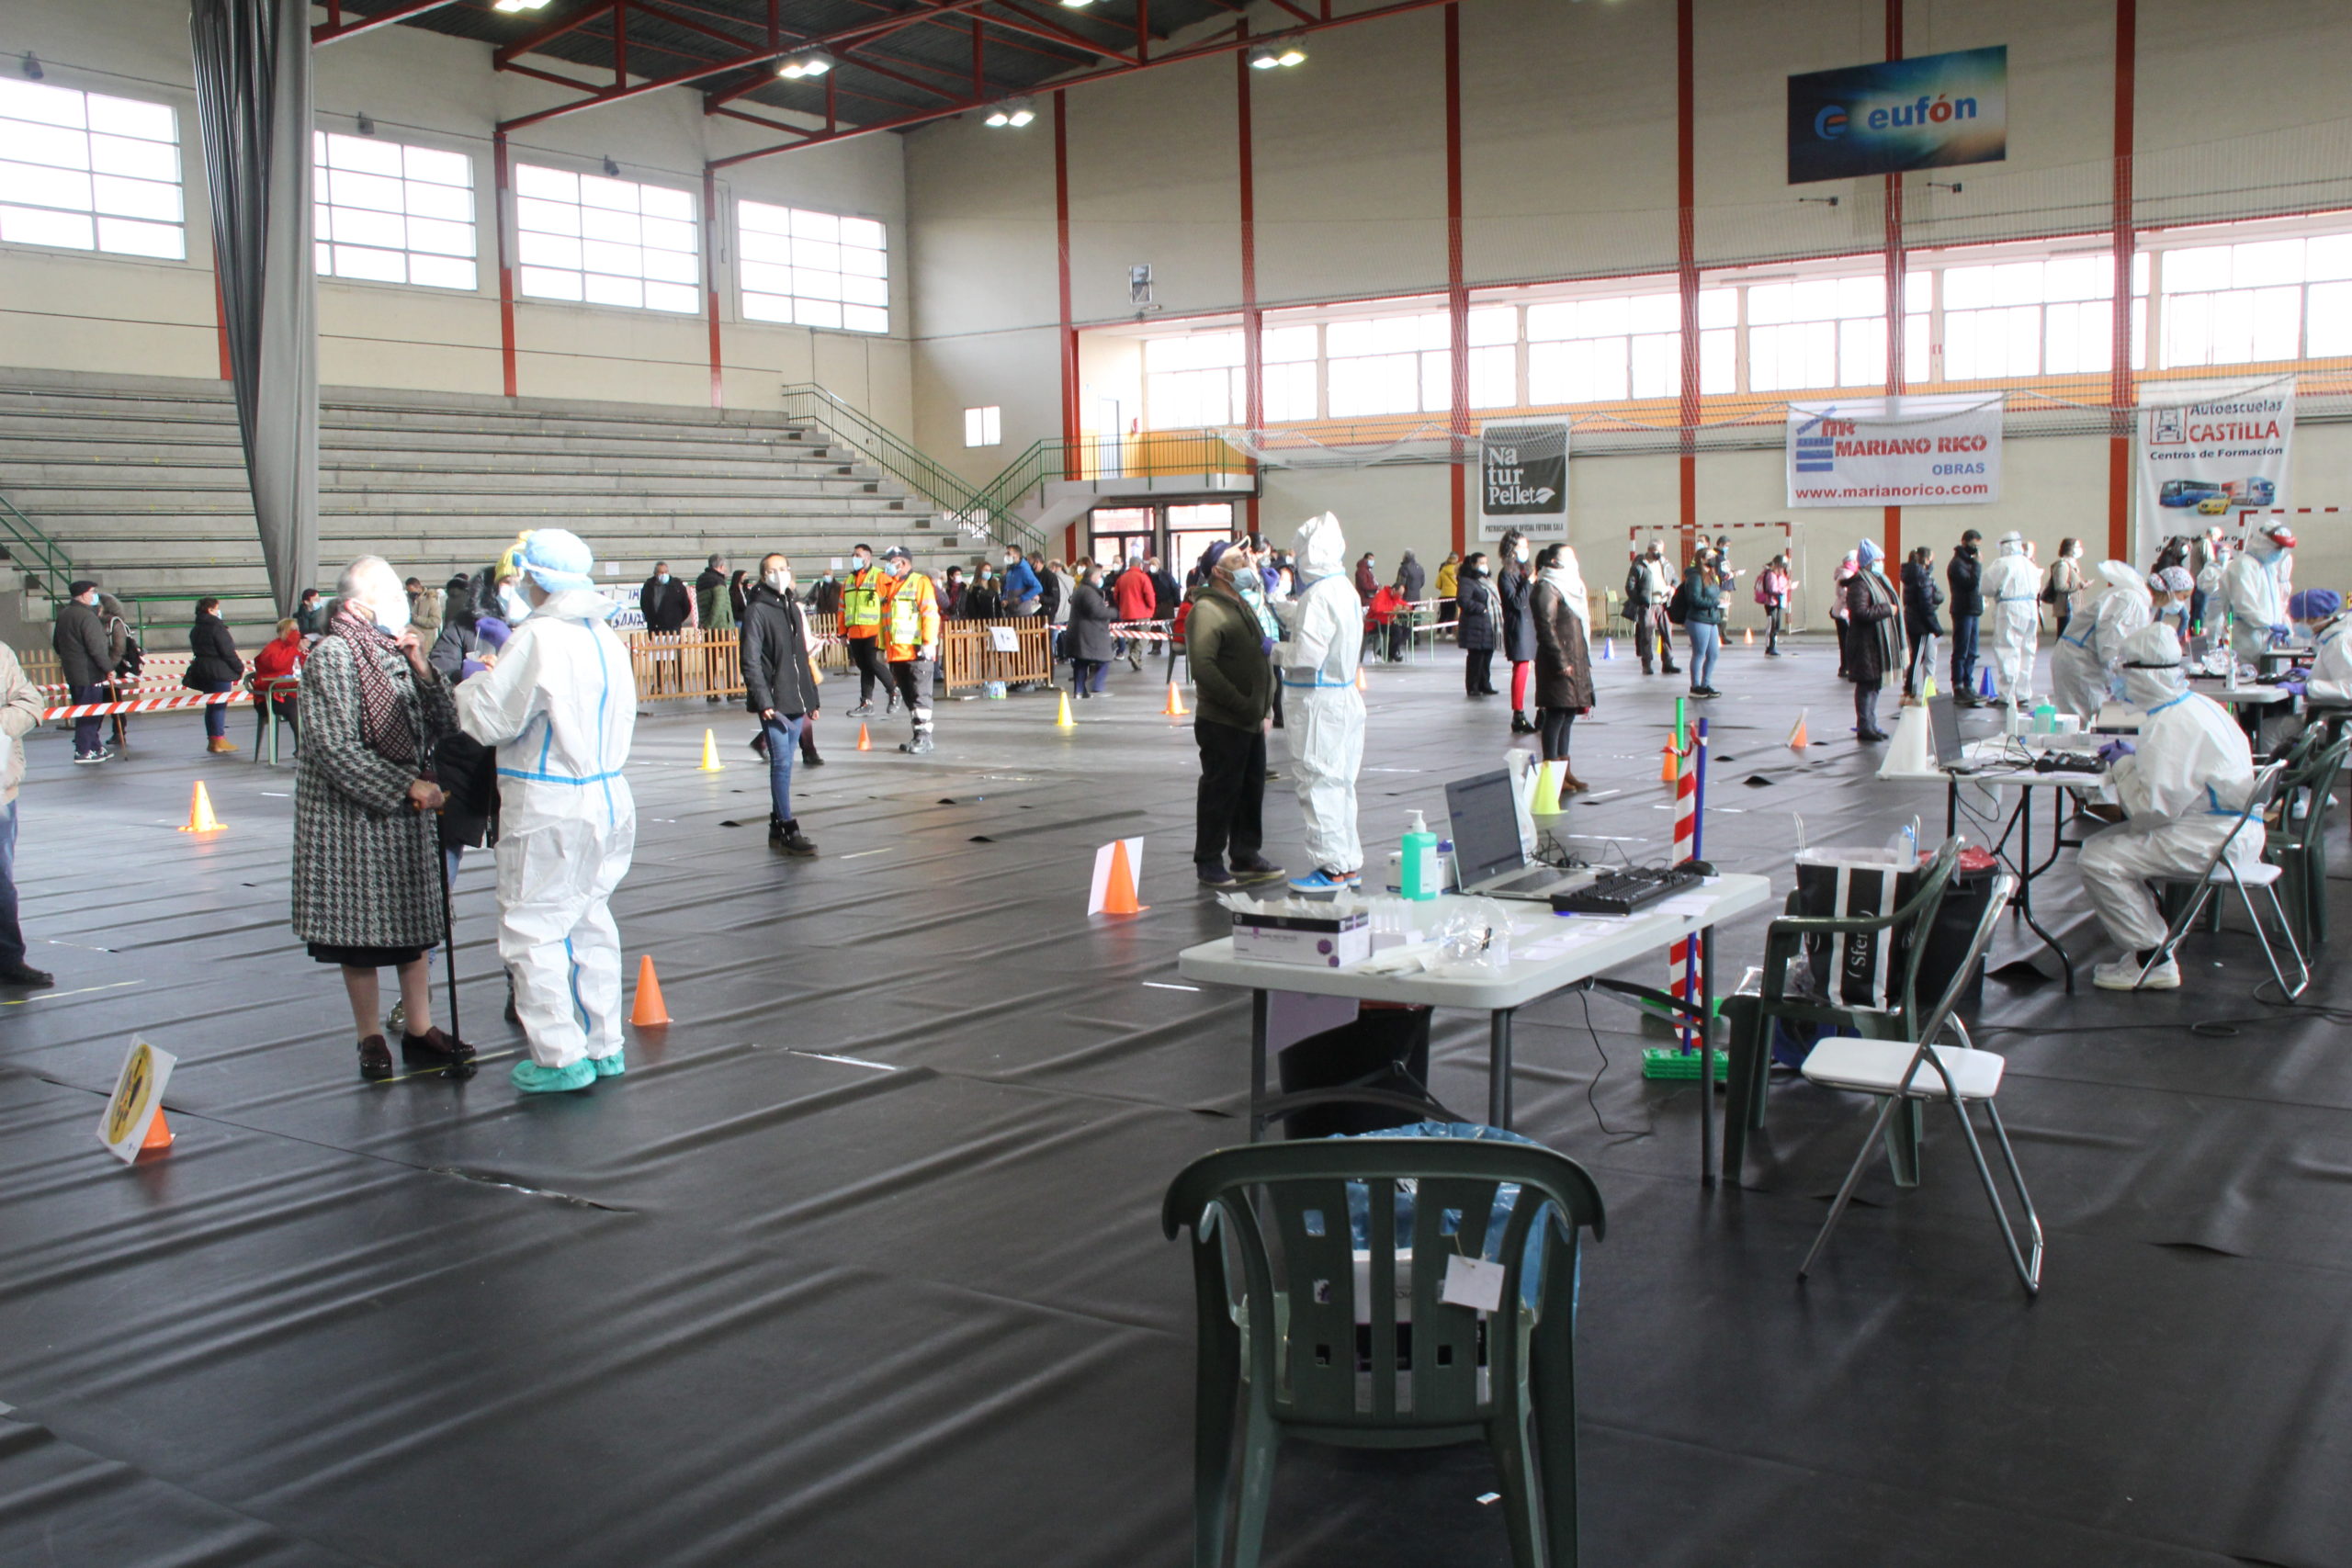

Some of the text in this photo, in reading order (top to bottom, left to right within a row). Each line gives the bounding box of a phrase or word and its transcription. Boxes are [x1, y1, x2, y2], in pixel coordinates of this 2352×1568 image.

[1868, 94, 1976, 130] eufón
[2190, 399, 2283, 416] Autoescuelas
[1835, 434, 1987, 457] MARIANO RICO
[2150, 446, 2283, 460] Centros de Formación
[1488, 446, 1519, 467] Na
[1487, 466, 1524, 485] tur
[1932, 462, 1985, 476] OBRAS
[1488, 485, 1535, 506] Pellet
[1795, 483, 1988, 500] www.marianorico.com
